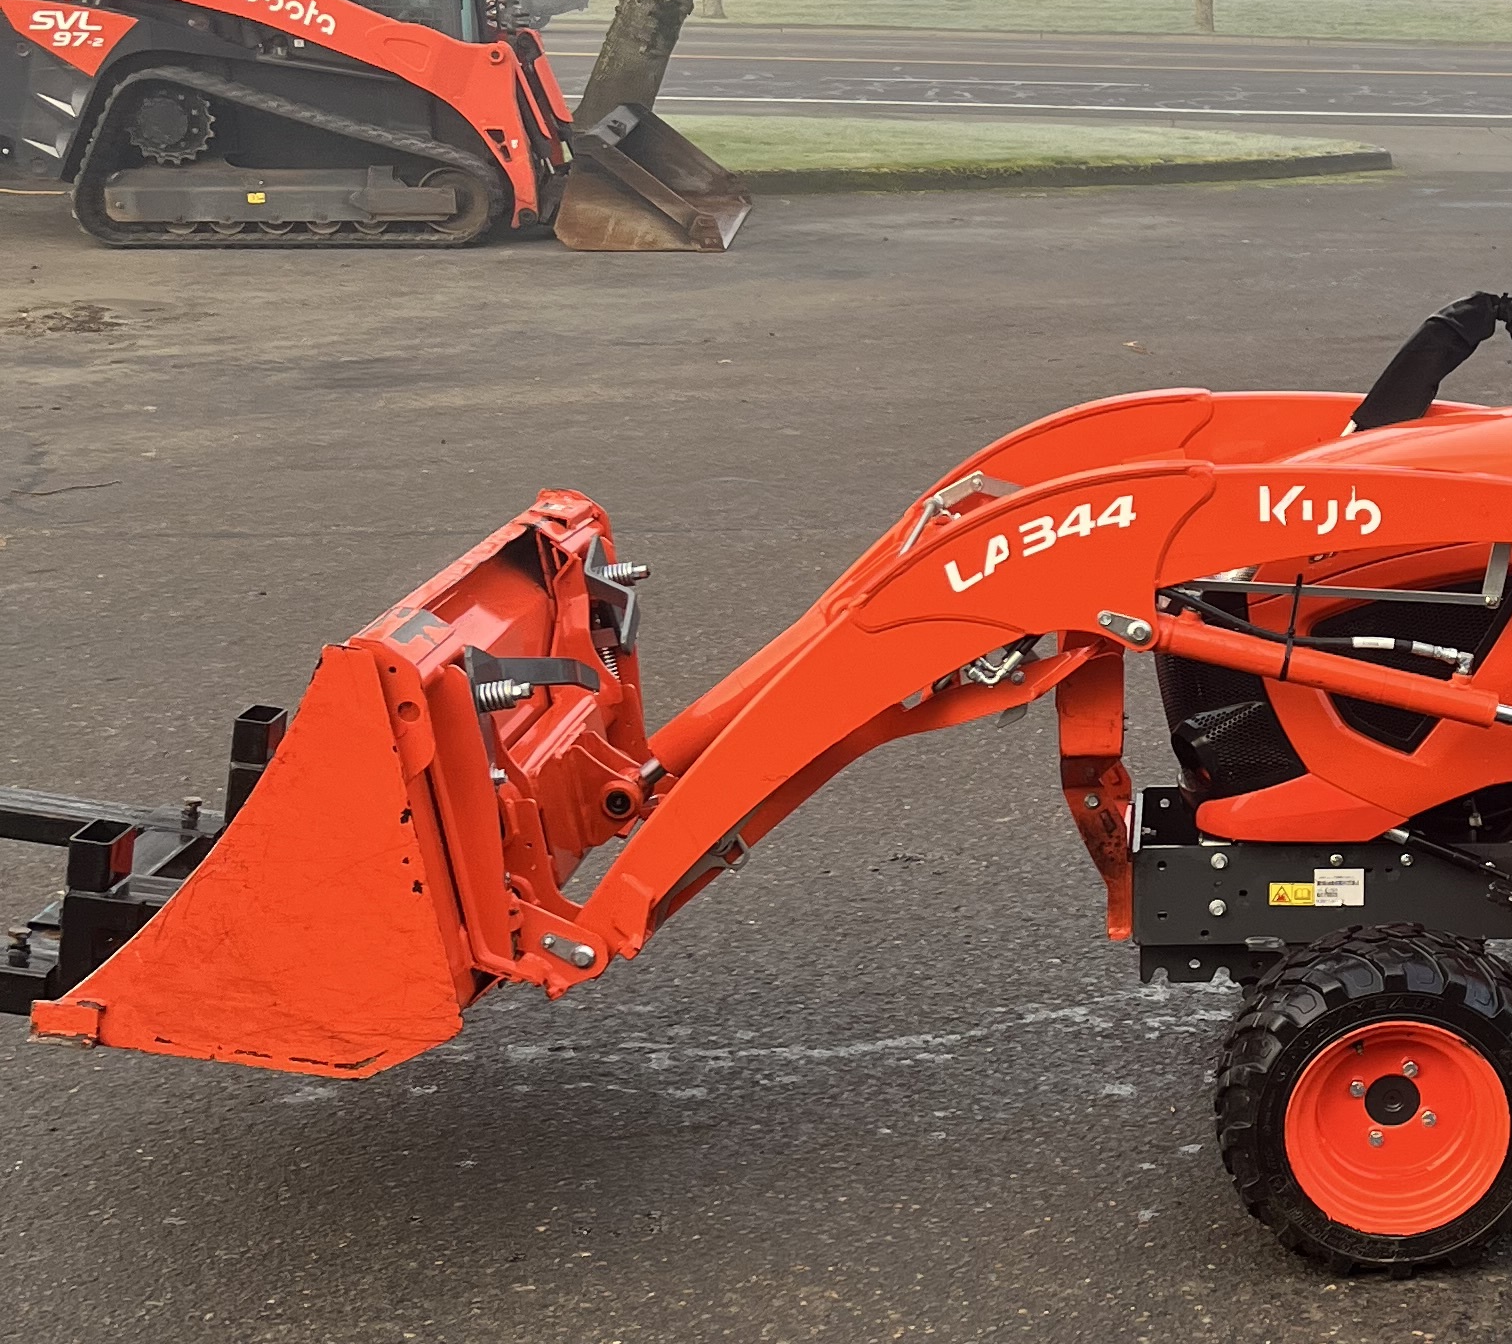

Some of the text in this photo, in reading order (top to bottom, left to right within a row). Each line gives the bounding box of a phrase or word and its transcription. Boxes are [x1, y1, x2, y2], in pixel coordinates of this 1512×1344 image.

[29, 10, 103, 31] SVL
[52, 31, 105, 47] 97-2
[944, 495, 1137, 593] LA 344
